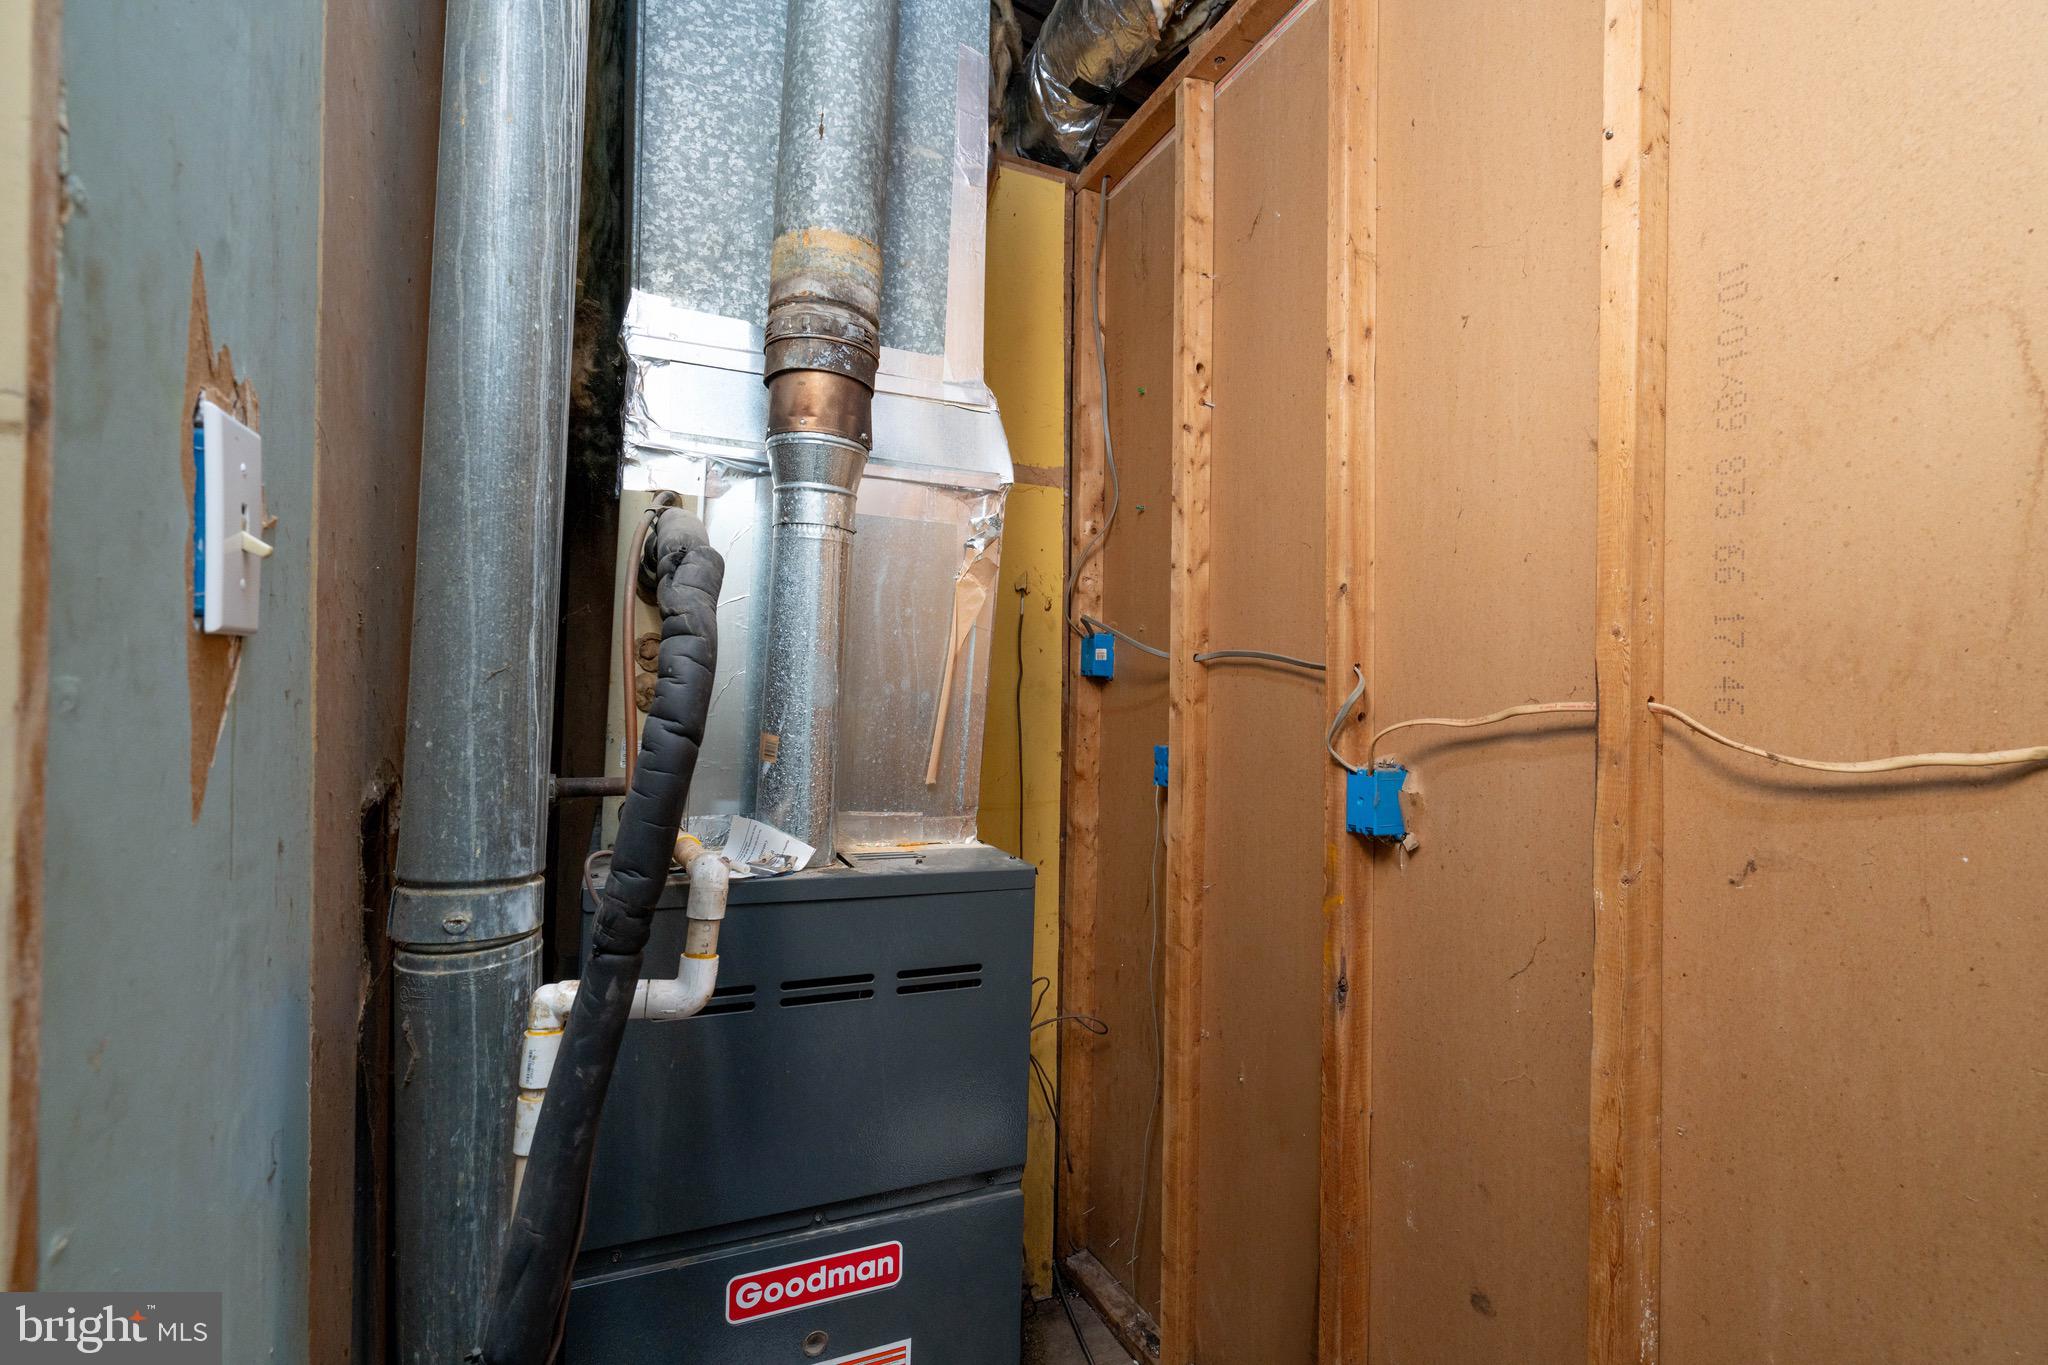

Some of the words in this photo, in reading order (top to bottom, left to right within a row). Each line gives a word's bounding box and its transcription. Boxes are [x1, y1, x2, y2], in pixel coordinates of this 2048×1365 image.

[1715, 455, 1746, 519] 833
[1713, 613, 1745, 716] 17:46
[735, 1255, 894, 1310] Goodman
